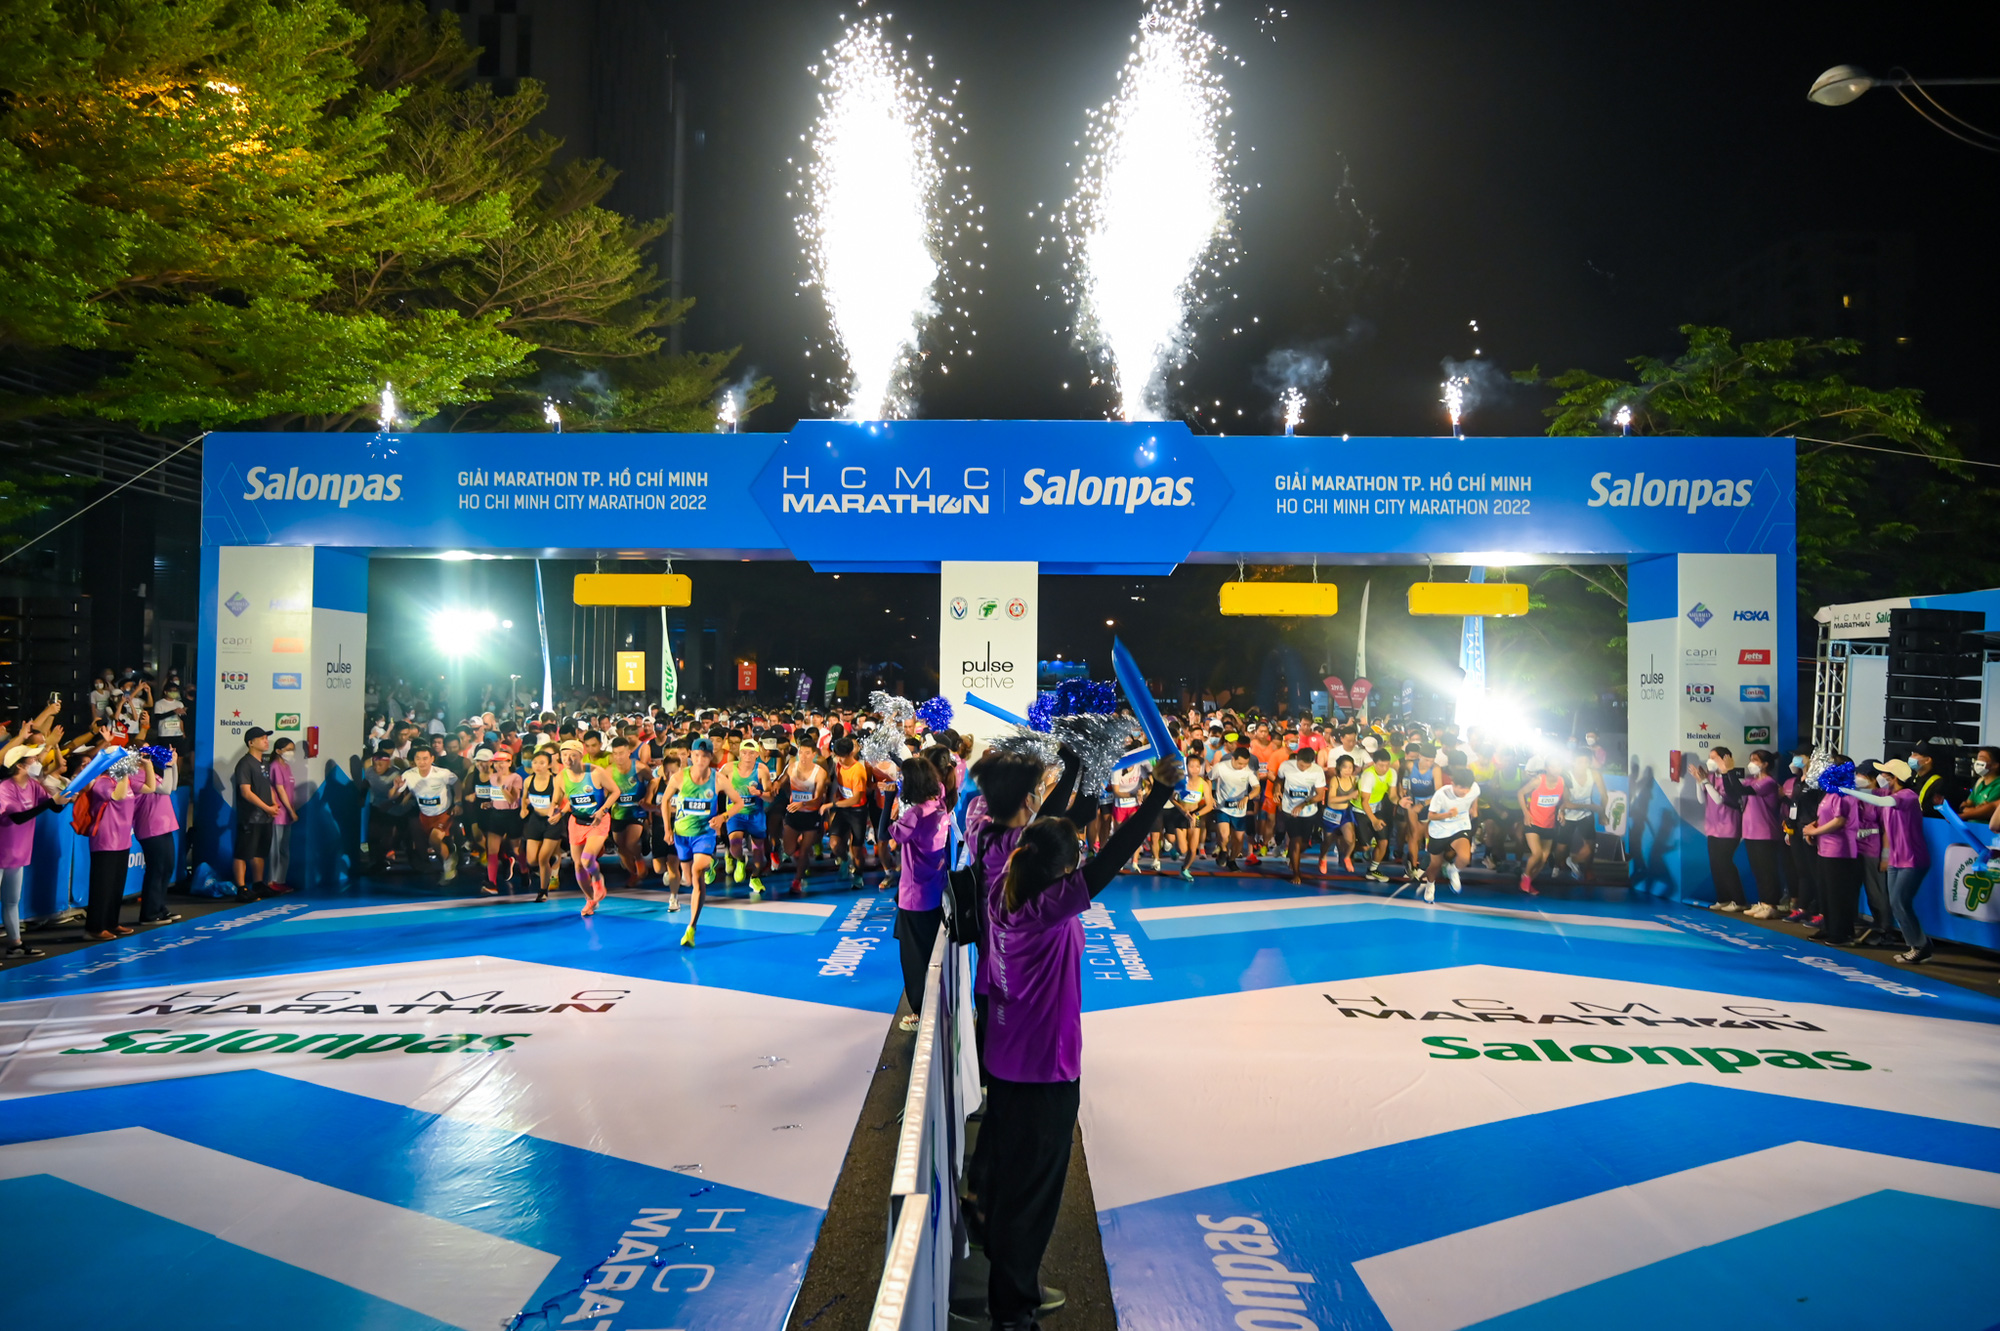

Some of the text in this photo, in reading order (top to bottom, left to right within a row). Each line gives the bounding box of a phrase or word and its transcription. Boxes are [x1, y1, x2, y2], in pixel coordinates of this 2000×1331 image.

[458, 467, 708, 487] GIẢI MARATHON TP. HỒ CHÍ MINH
[1275, 472, 1532, 491] GIẢI MARATHON TP. HỒ CHÍ MINH
[243, 466, 403, 509] Salonpas
[1019, 467, 1196, 514] Salonpas
[1587, 471, 1754, 514] Salonpas
[459, 494, 707, 510] HO CHI MINH CITY MARATHON 2022
[782, 493, 990, 514] MARATHON
[1276, 498, 1531, 515] HO CHI MINH CITY MARATHON 2022
[1733, 610, 1770, 621] HOKA
[1834, 621, 1871, 629] MARATHON
[222, 636, 252, 646] capri
[326, 643, 352, 676] pulse
[962, 641, 1014, 675] pulse
[1686, 648, 1717, 658] capri
[1744, 652, 1763, 661] jetts
[628, 670, 635, 683] 1
[1641, 654, 1664, 687] pulse
[326, 676, 352, 689] active
[745, 676, 750, 686] 2
[962, 673, 1014, 689] active
[1641, 687, 1664, 700] active
[1749, 730, 1767, 738] MILO
[817, 936, 880, 976] Salonpas
[59, 1028, 533, 1060] Salonpas
[1421, 1035, 1873, 1074] Salonpas
[1196, 1214, 1320, 1331] onpas
